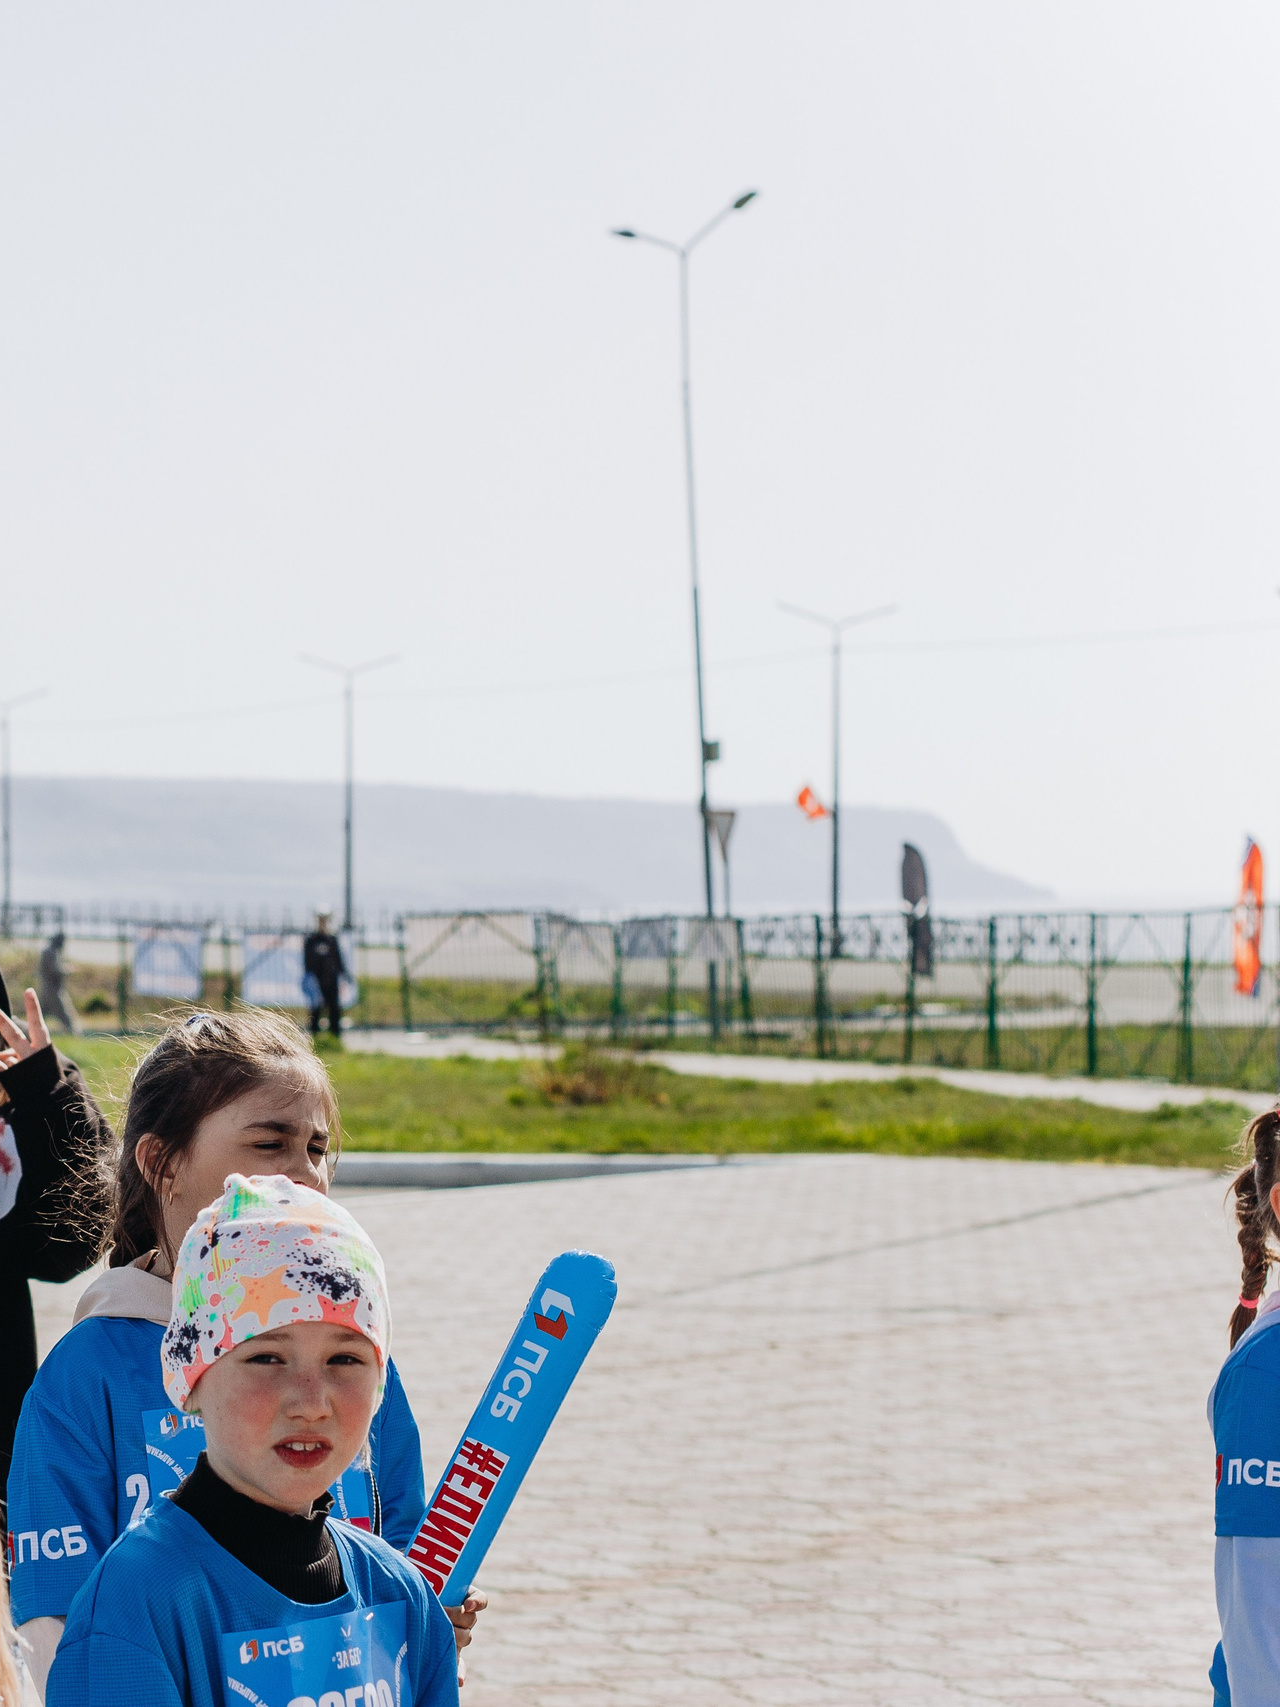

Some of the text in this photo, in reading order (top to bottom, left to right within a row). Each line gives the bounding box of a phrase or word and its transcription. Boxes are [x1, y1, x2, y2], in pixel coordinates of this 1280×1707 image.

[490, 1339, 549, 1423] ПСБ
[18, 1524, 88, 1564] ПСБ
[262, 1635, 305, 1658] ПСБ
